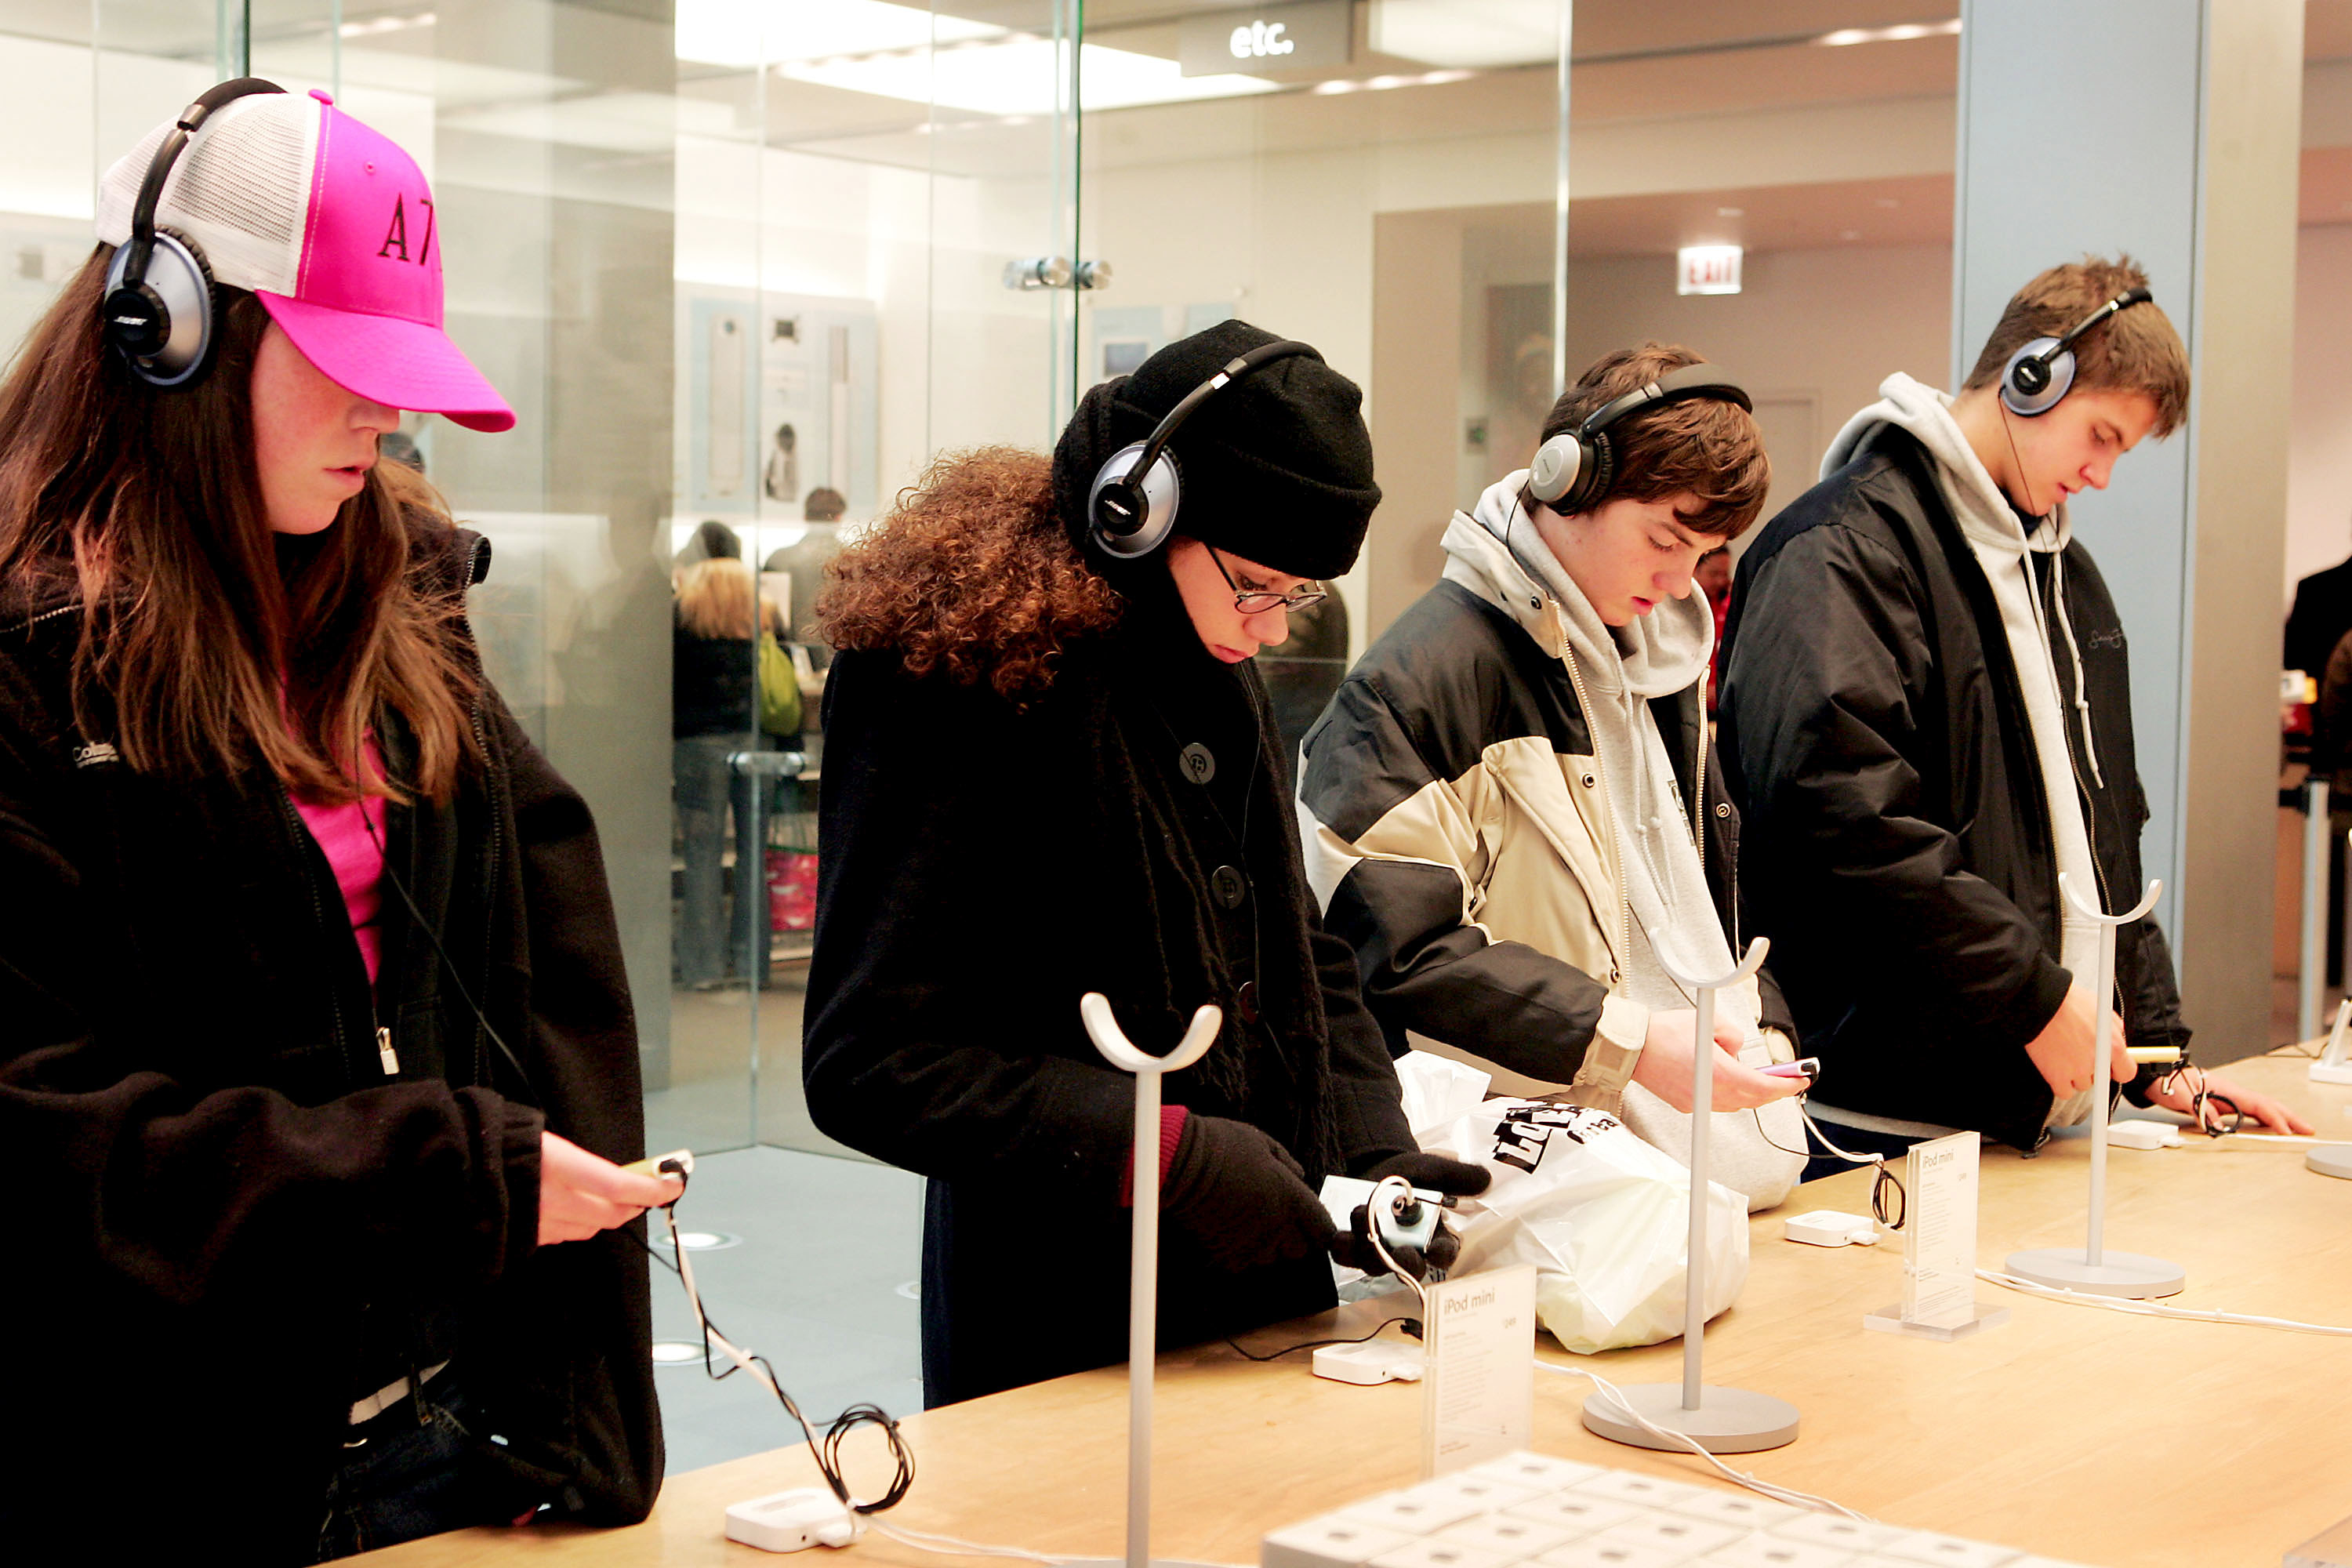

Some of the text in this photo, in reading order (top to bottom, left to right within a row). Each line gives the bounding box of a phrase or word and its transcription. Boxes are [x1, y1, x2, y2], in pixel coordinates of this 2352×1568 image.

[1229, 20, 1294, 59] etc.
[1922, 1148, 1955, 1169] iPod mini
[1443, 1287, 1495, 1315] iPod mini
